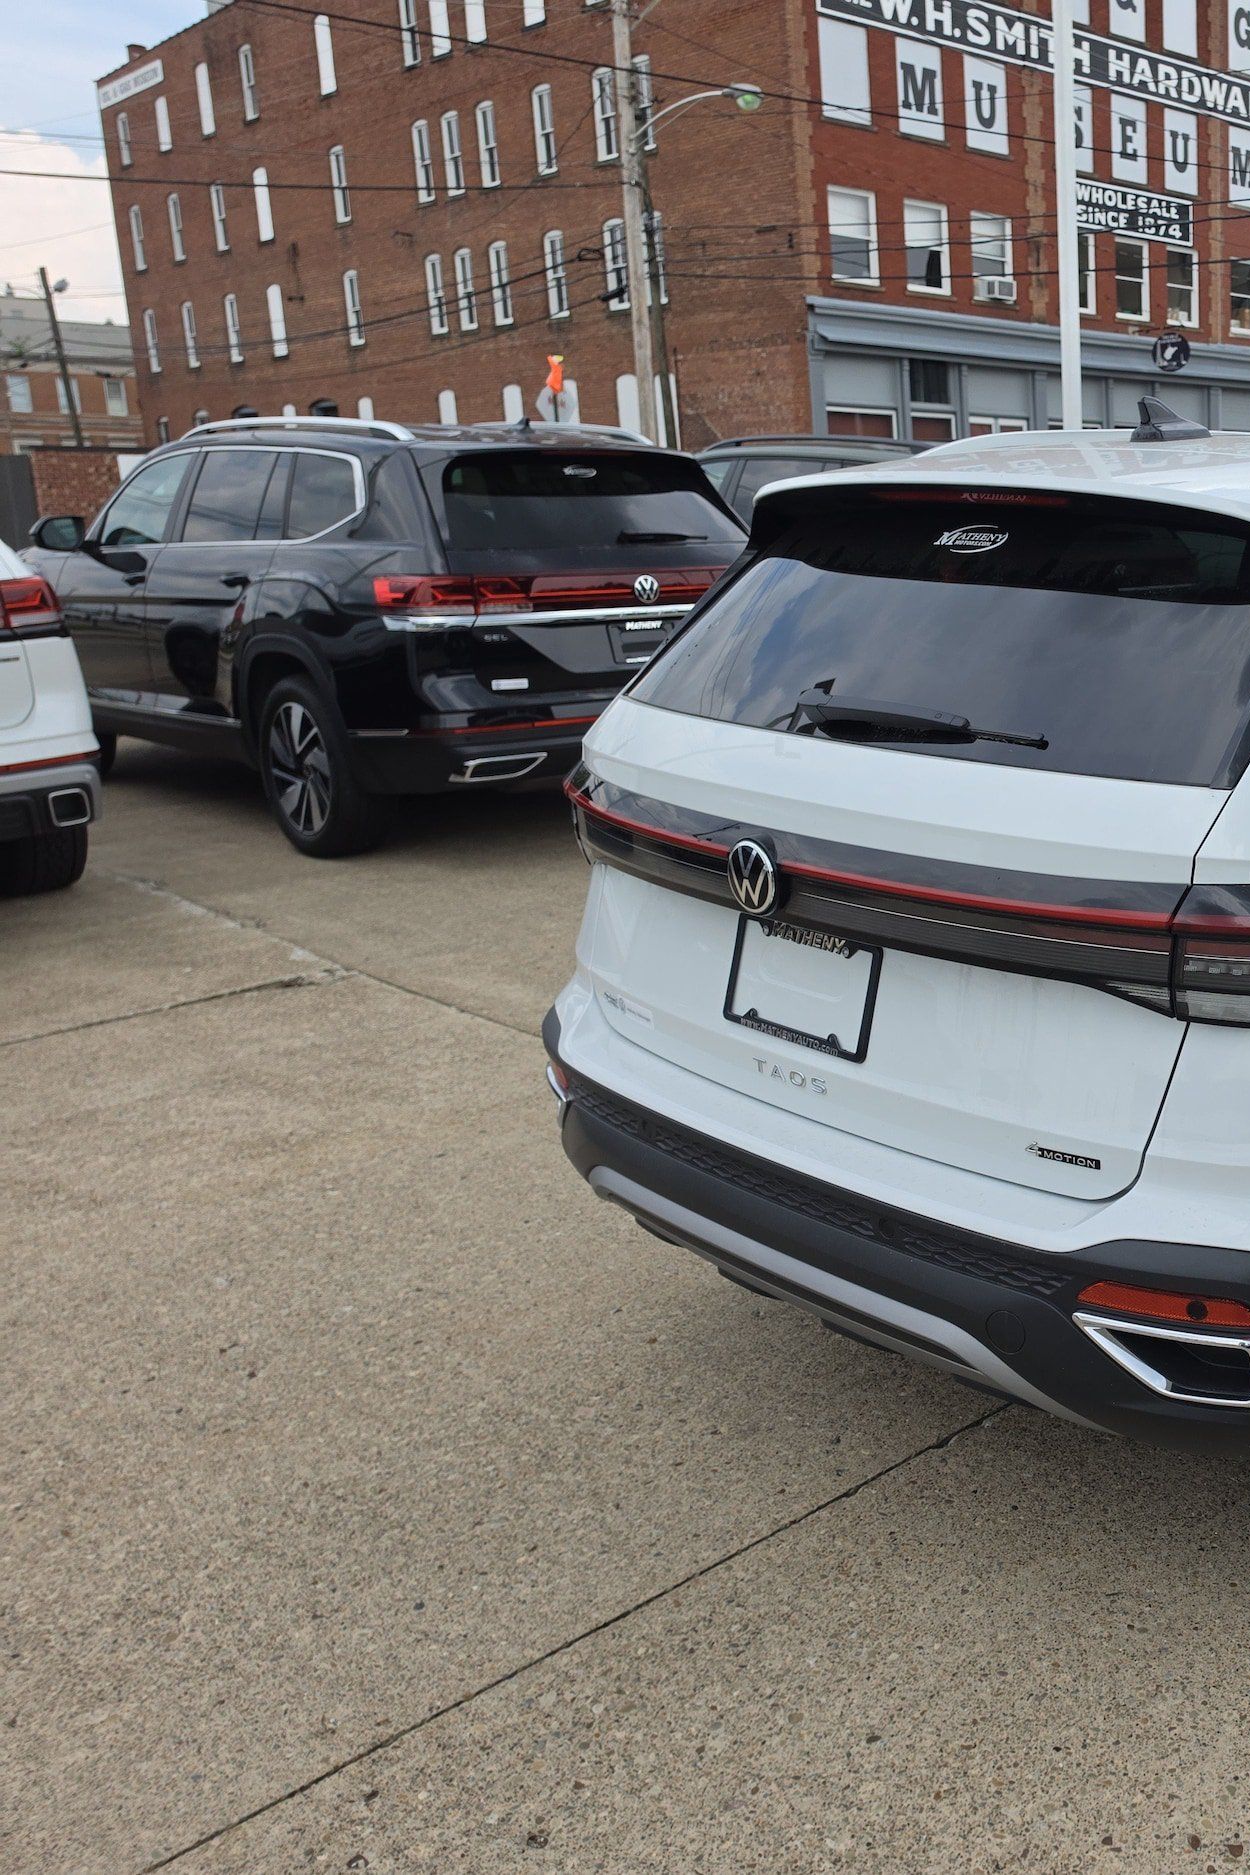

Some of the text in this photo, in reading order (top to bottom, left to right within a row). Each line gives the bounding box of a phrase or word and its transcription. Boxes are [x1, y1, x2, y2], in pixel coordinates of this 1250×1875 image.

[1075, 183, 1180, 219] WHOLESALE
[1076, 204, 1130, 228] SINCE
[933, 531, 1006, 546] MATHENY
[772, 920, 847, 956] MATHENY
[752, 1057, 828, 1095] TAOS
